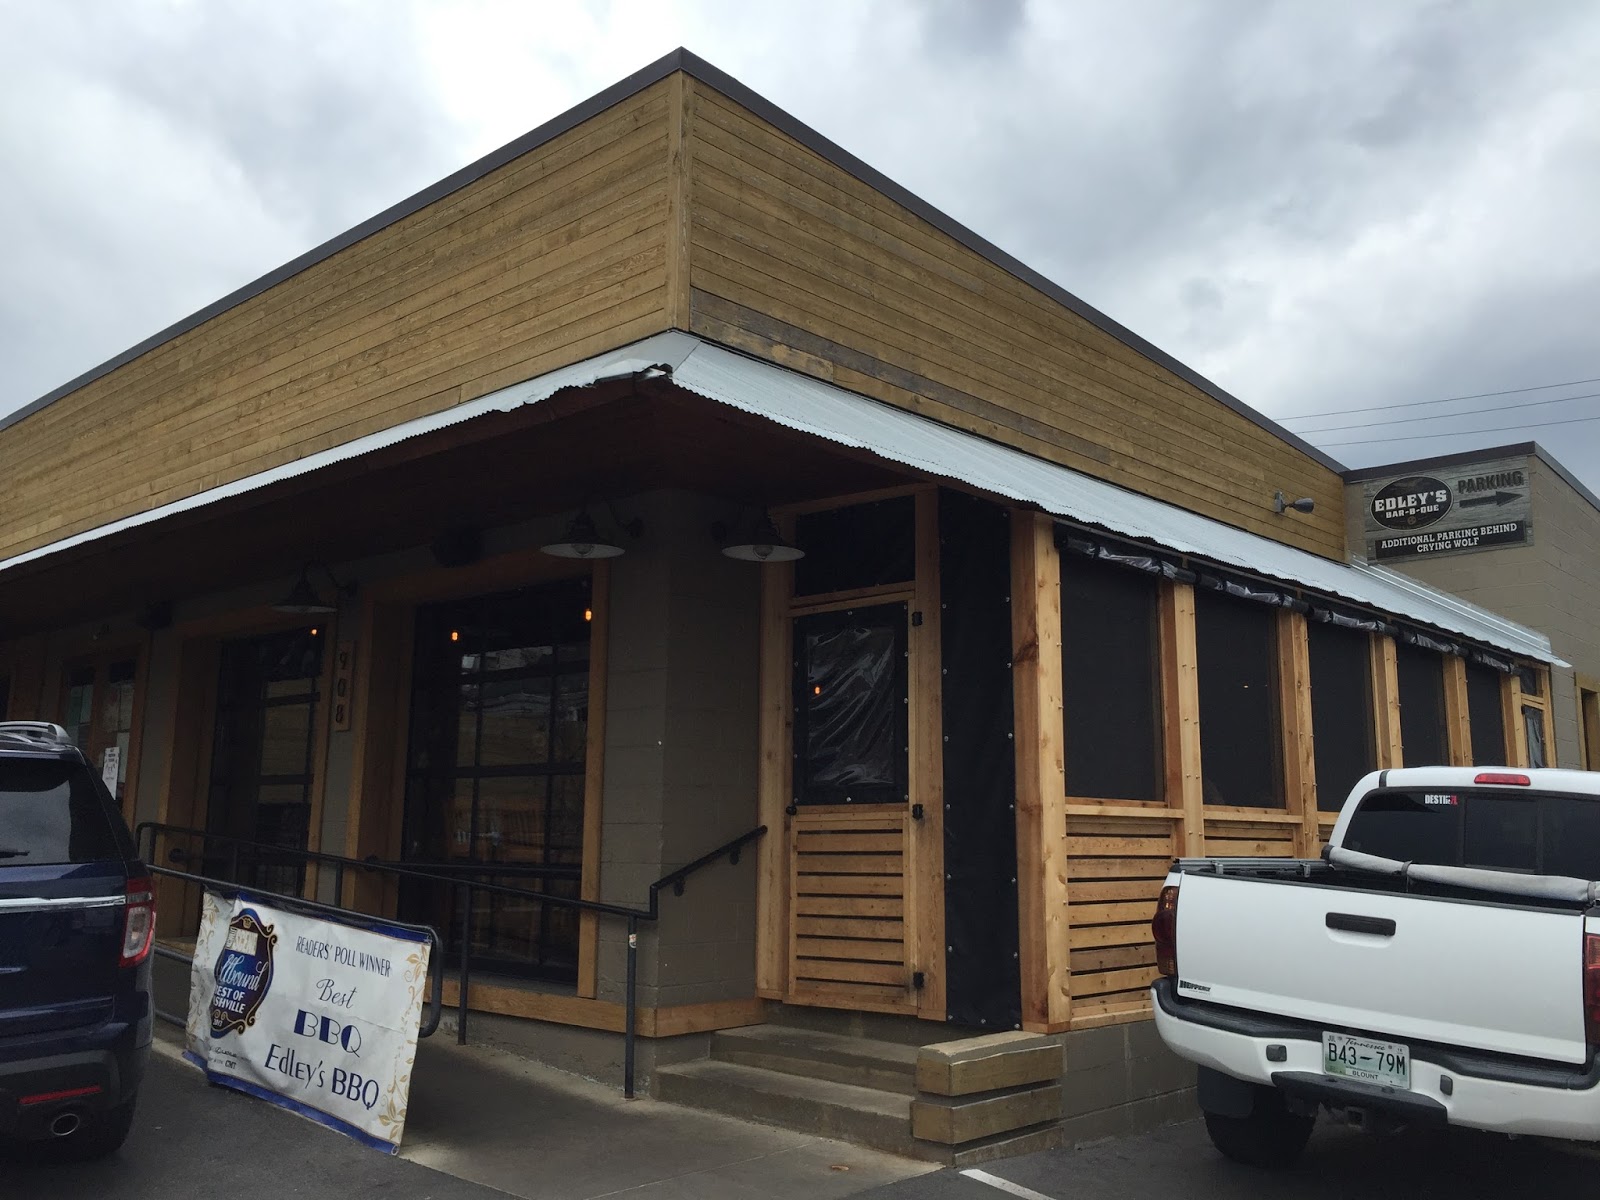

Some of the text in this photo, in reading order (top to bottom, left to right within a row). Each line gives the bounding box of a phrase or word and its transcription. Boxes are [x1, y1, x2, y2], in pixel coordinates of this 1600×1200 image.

[1458, 471, 1524, 494] PARKING
[1374, 489, 1447, 512] EDLEY'S
[1385, 504, 1439, 518] BAR-B-QUE
[1381, 522, 1517, 549] ADDITIONAL PARKING BEHIND
[1417, 537, 1480, 553] CRYING WOLF
[295, 935, 391, 978] READERS' POLL WINNER
[213, 995, 246, 1014] SHVILLE
[233, 990, 245, 1001] OF
[316, 978, 357, 1009] Best
[293, 1009, 363, 1058] BBQ
[1345, 1037, 1386, 1051] Tennessee
[1352, 1070, 1379, 1080] BLOUNT
[331, 1067, 380, 1110] BBQ
